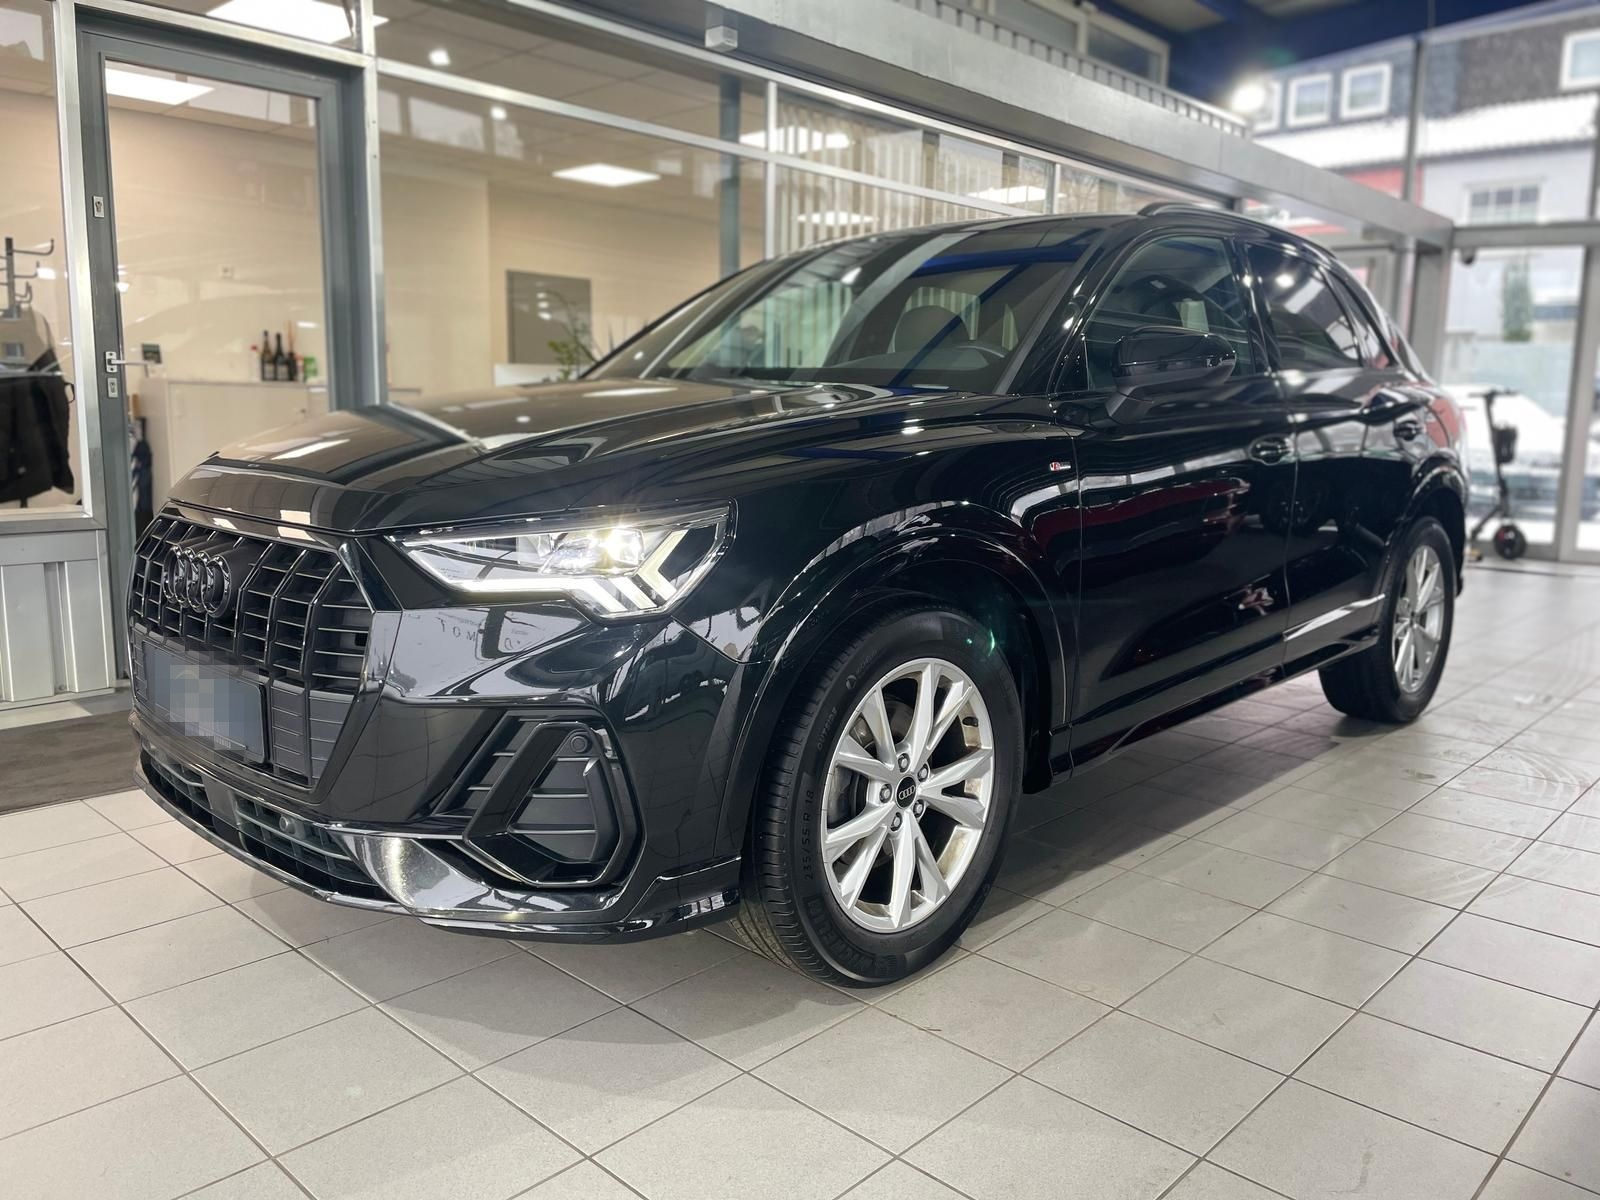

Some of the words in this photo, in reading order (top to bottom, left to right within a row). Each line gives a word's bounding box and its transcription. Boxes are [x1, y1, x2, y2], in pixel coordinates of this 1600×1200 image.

[805, 790, 815, 804] 18
[803, 812, 812, 822] R
[802, 828, 814, 880] 235/55
